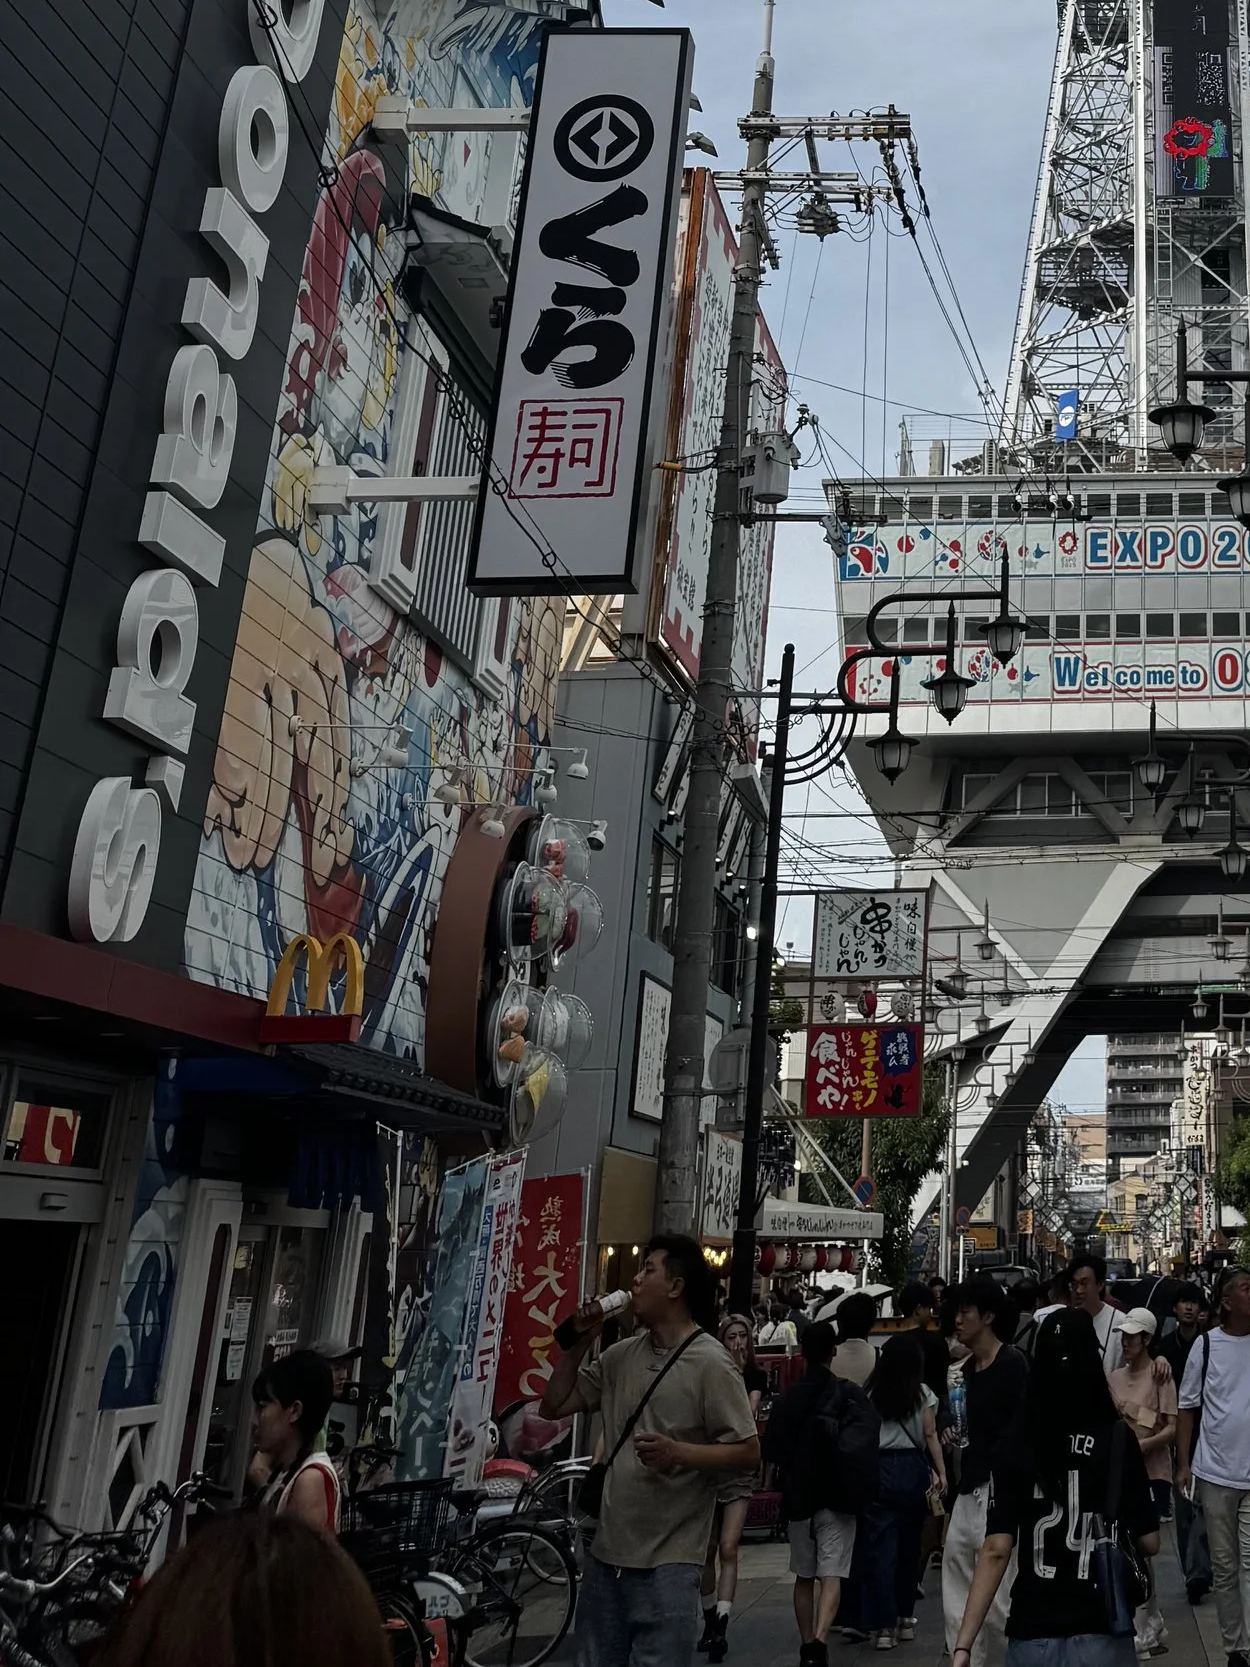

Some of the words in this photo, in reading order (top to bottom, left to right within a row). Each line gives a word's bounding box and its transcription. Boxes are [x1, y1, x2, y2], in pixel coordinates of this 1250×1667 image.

[520, 404, 610, 491] 寿司
[1089, 530, 1208, 564] EXPO
[1053, 656, 1174, 688] Welcome
[1180, 665, 1202, 685] to
[860, 1029, 880, 1109] ゲテモノ
